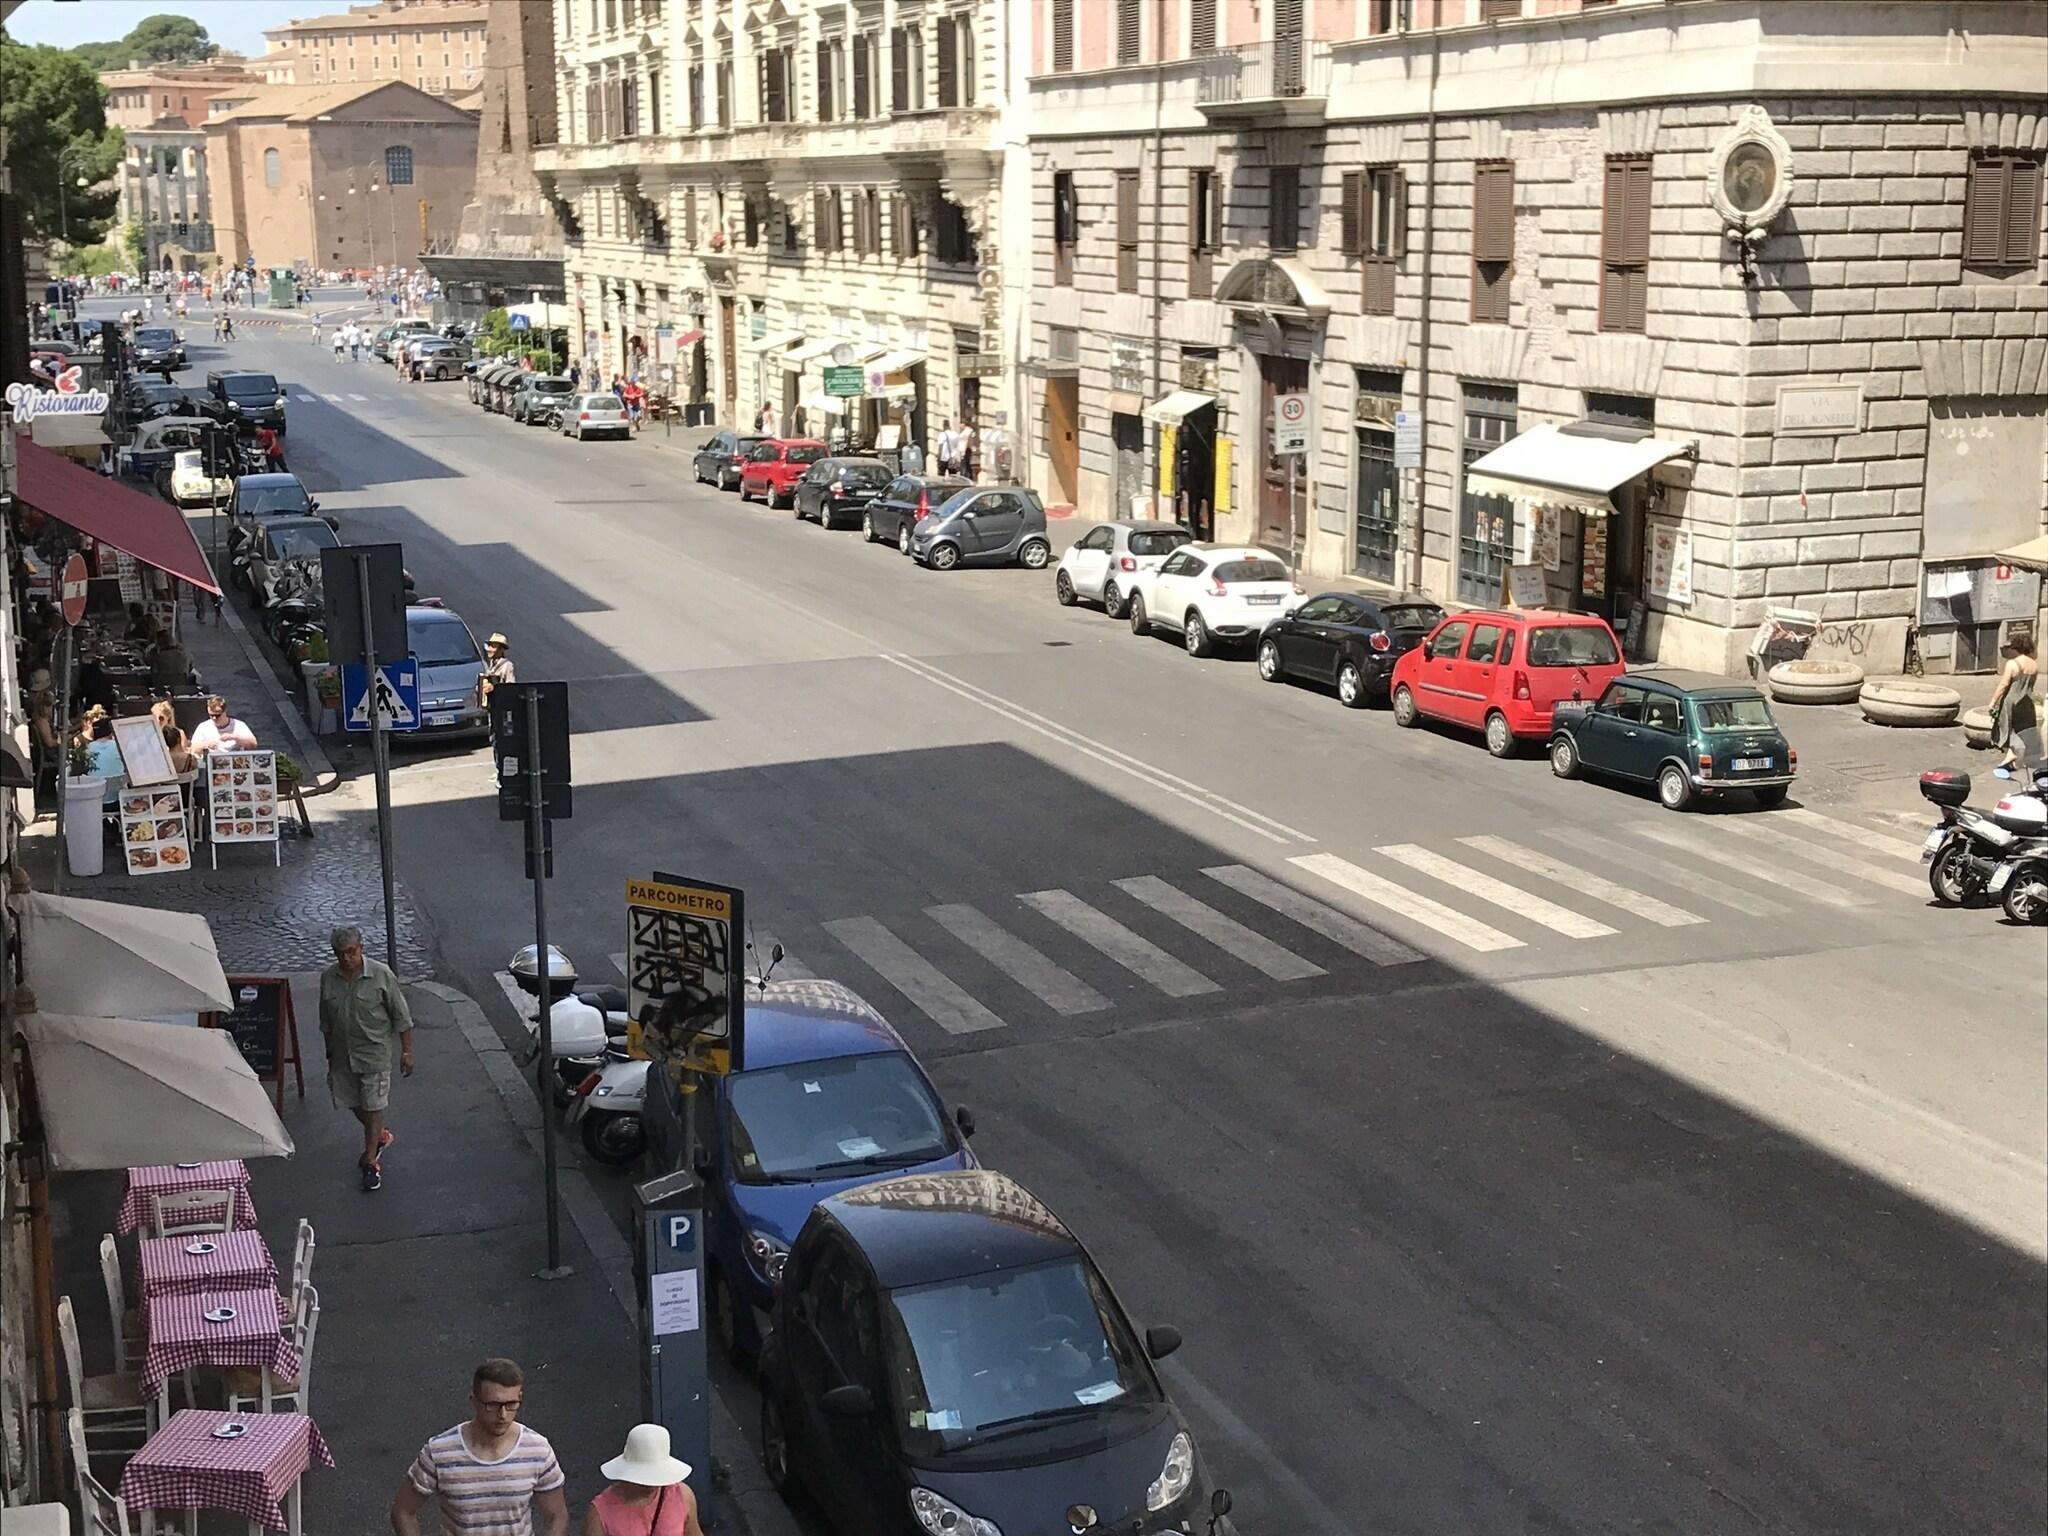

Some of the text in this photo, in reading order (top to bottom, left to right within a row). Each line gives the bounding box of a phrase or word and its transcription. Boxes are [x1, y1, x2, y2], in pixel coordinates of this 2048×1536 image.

[7, 384, 106, 421] Ristorante
[1287, 403, 1299, 414] 30
[1811, 396, 1830, 406] VIA
[630, 886, 725, 912] PARCOMETRO
[670, 1215, 691, 1248] P
